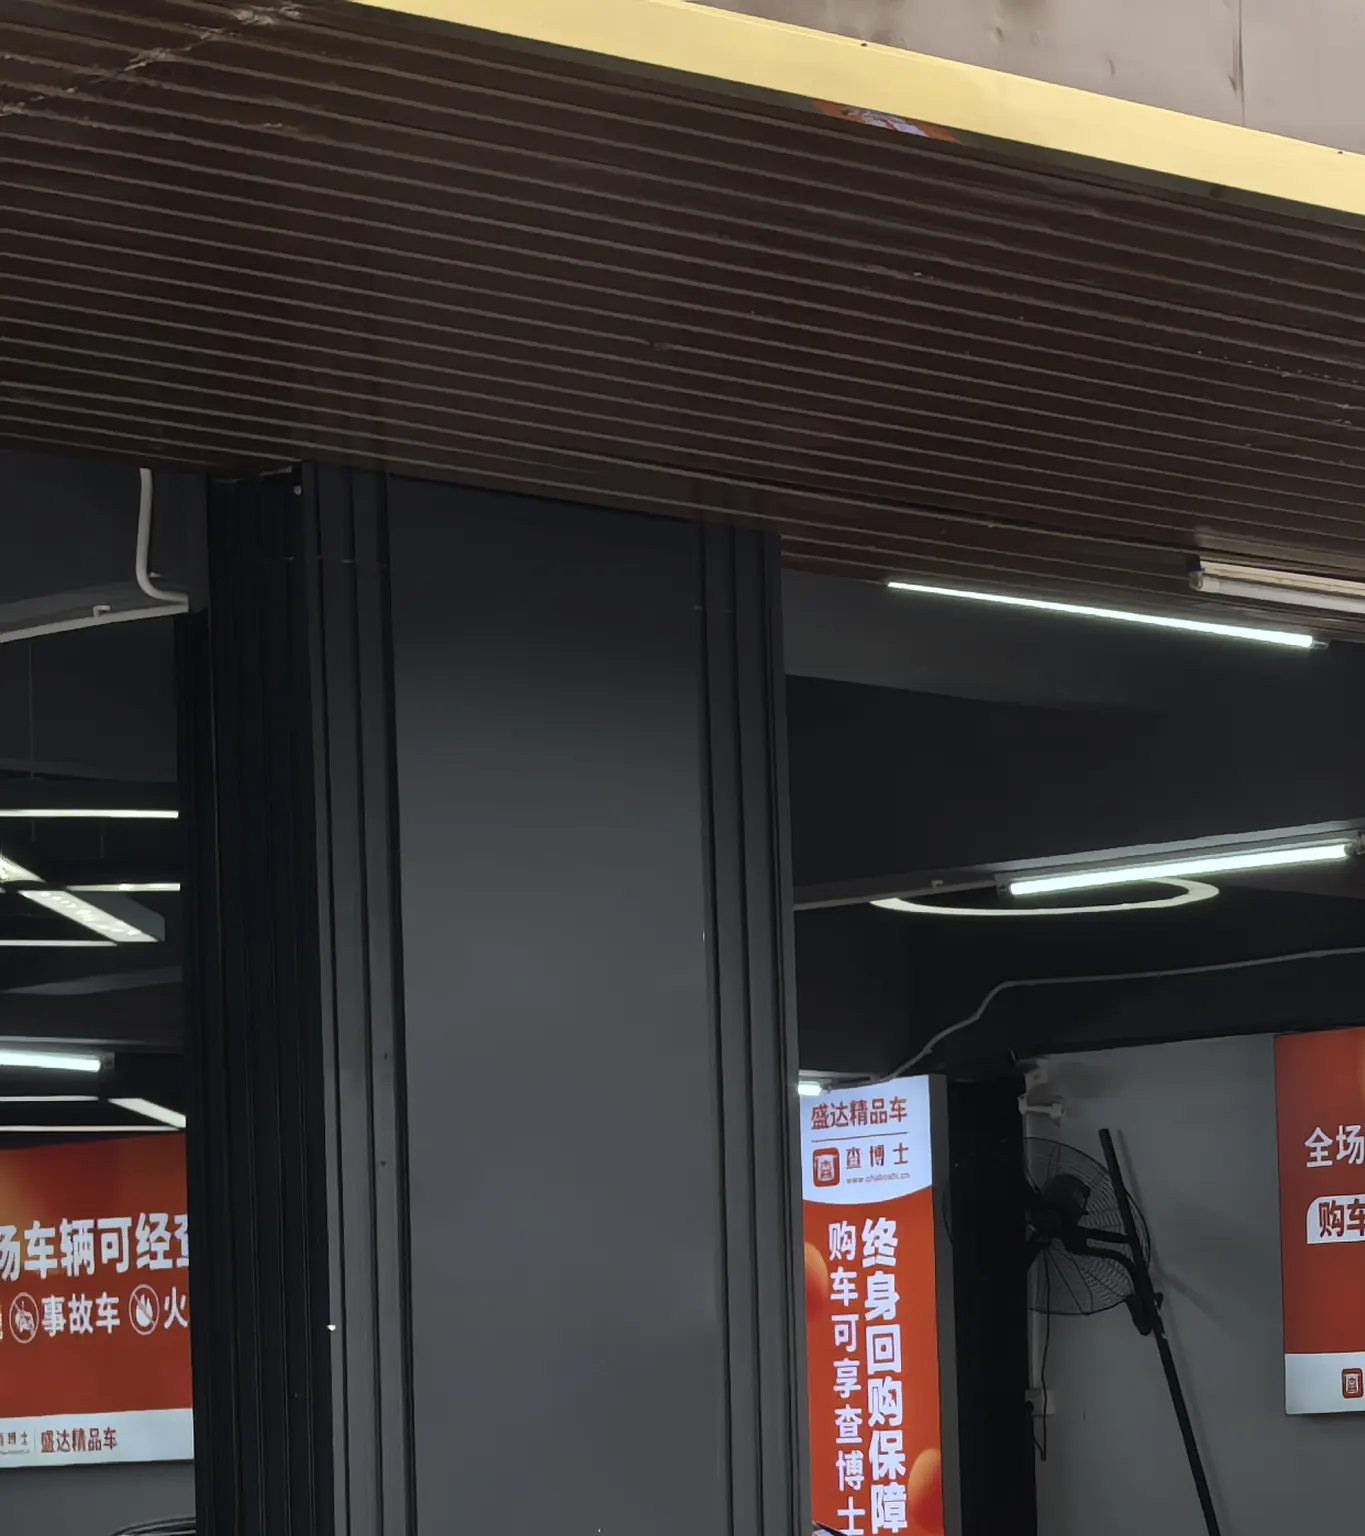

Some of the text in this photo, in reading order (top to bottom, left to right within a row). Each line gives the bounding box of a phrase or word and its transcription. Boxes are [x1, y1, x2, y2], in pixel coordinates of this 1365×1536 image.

[811, 1096, 909, 1130] 盛达精品车
[41, 1291, 121, 1337] 事故车
[862, 1217, 908, 1535] 终身回购保障
[41, 1426, 118, 1454] 盛达精品车
